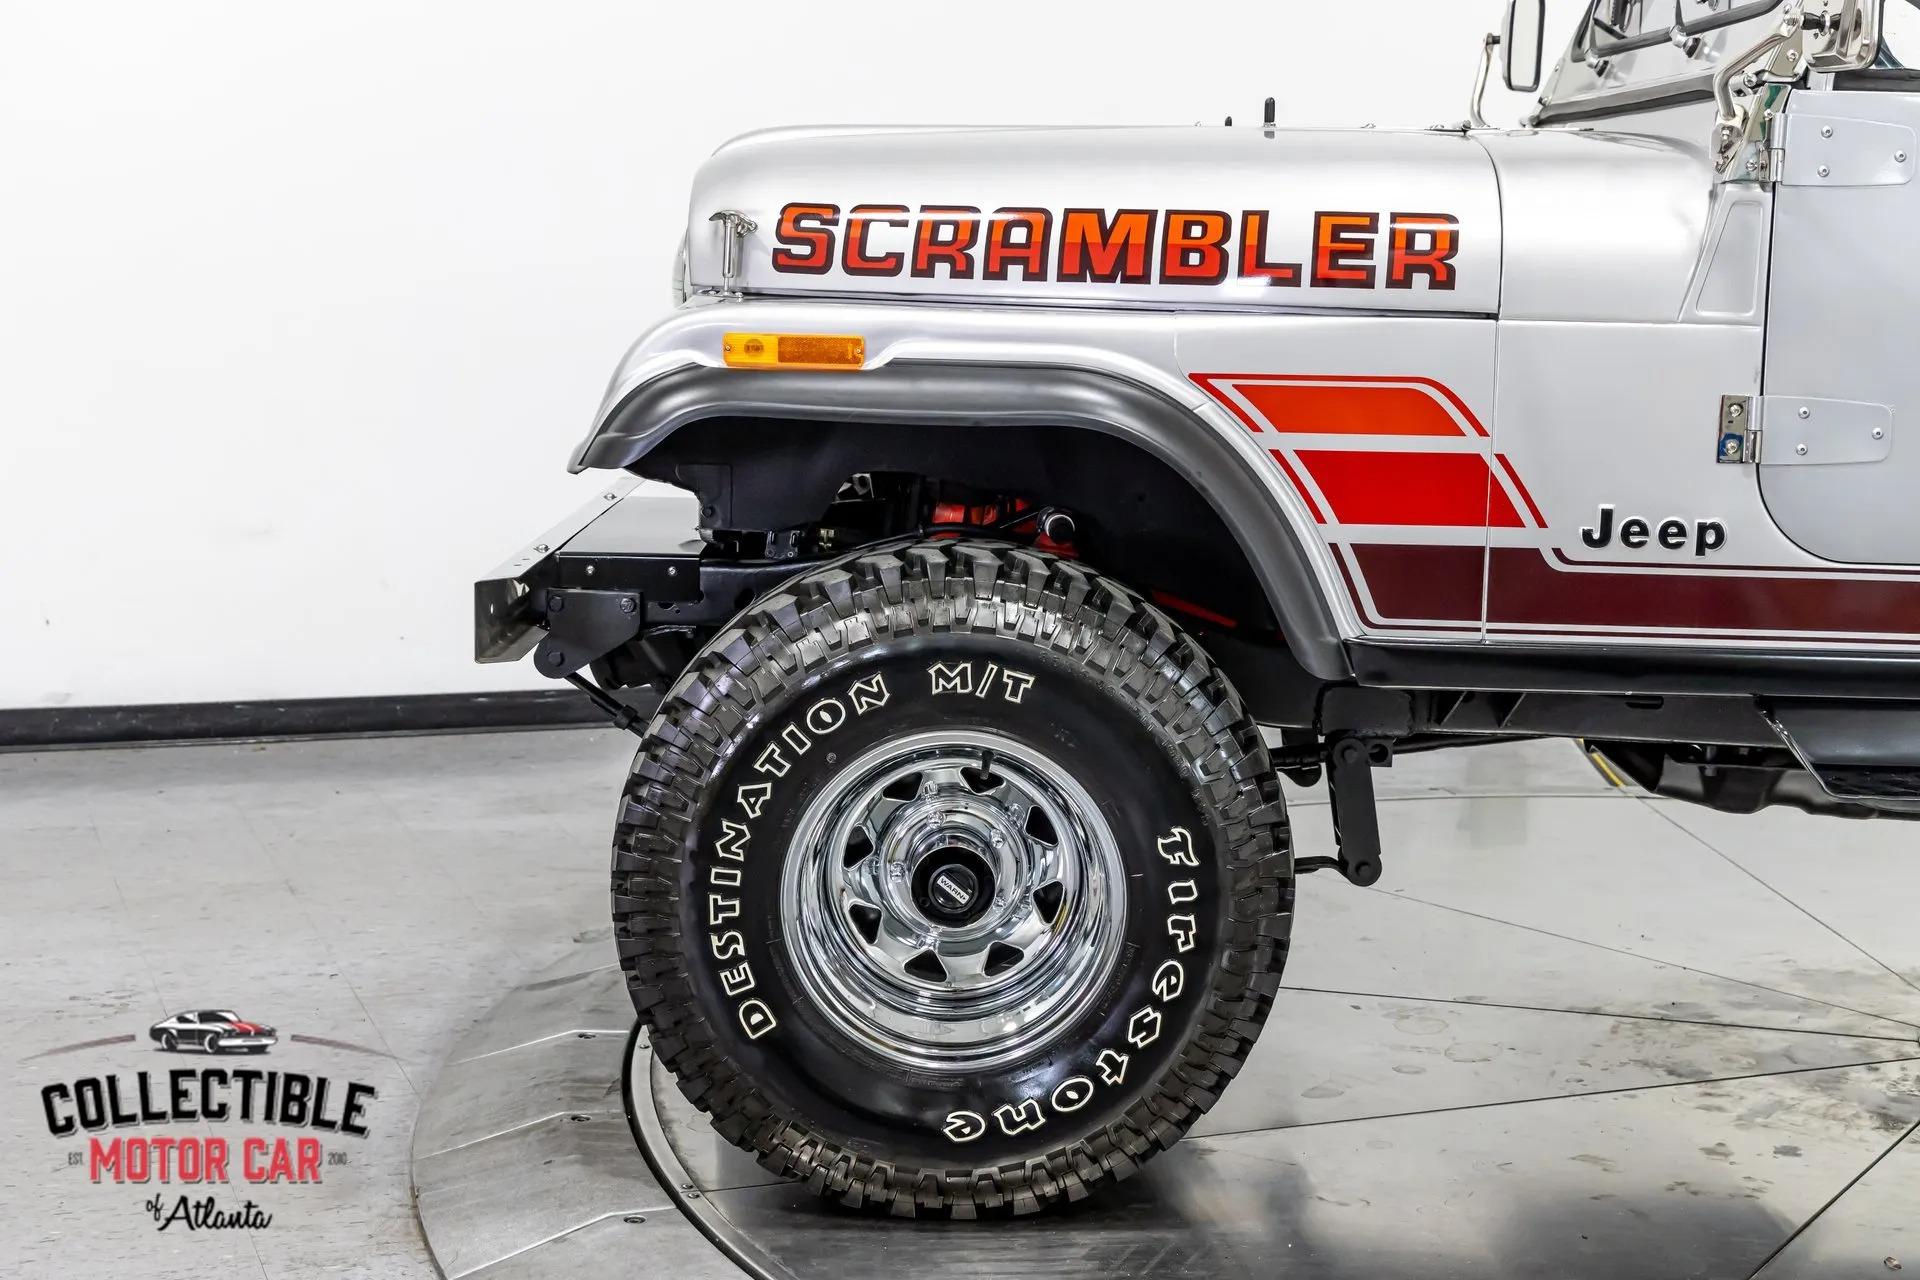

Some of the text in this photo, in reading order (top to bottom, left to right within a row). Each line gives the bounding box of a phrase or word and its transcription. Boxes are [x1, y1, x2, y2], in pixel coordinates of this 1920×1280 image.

[771, 202, 1460, 291] SCRAMBLER
[1580, 504, 1728, 558] Jeep
[709, 672, 891, 1041] DESTINATION
[927, 660, 1035, 704] M/T
[940, 877, 965, 900] WARN
[943, 827, 1198, 1144] Firestone
